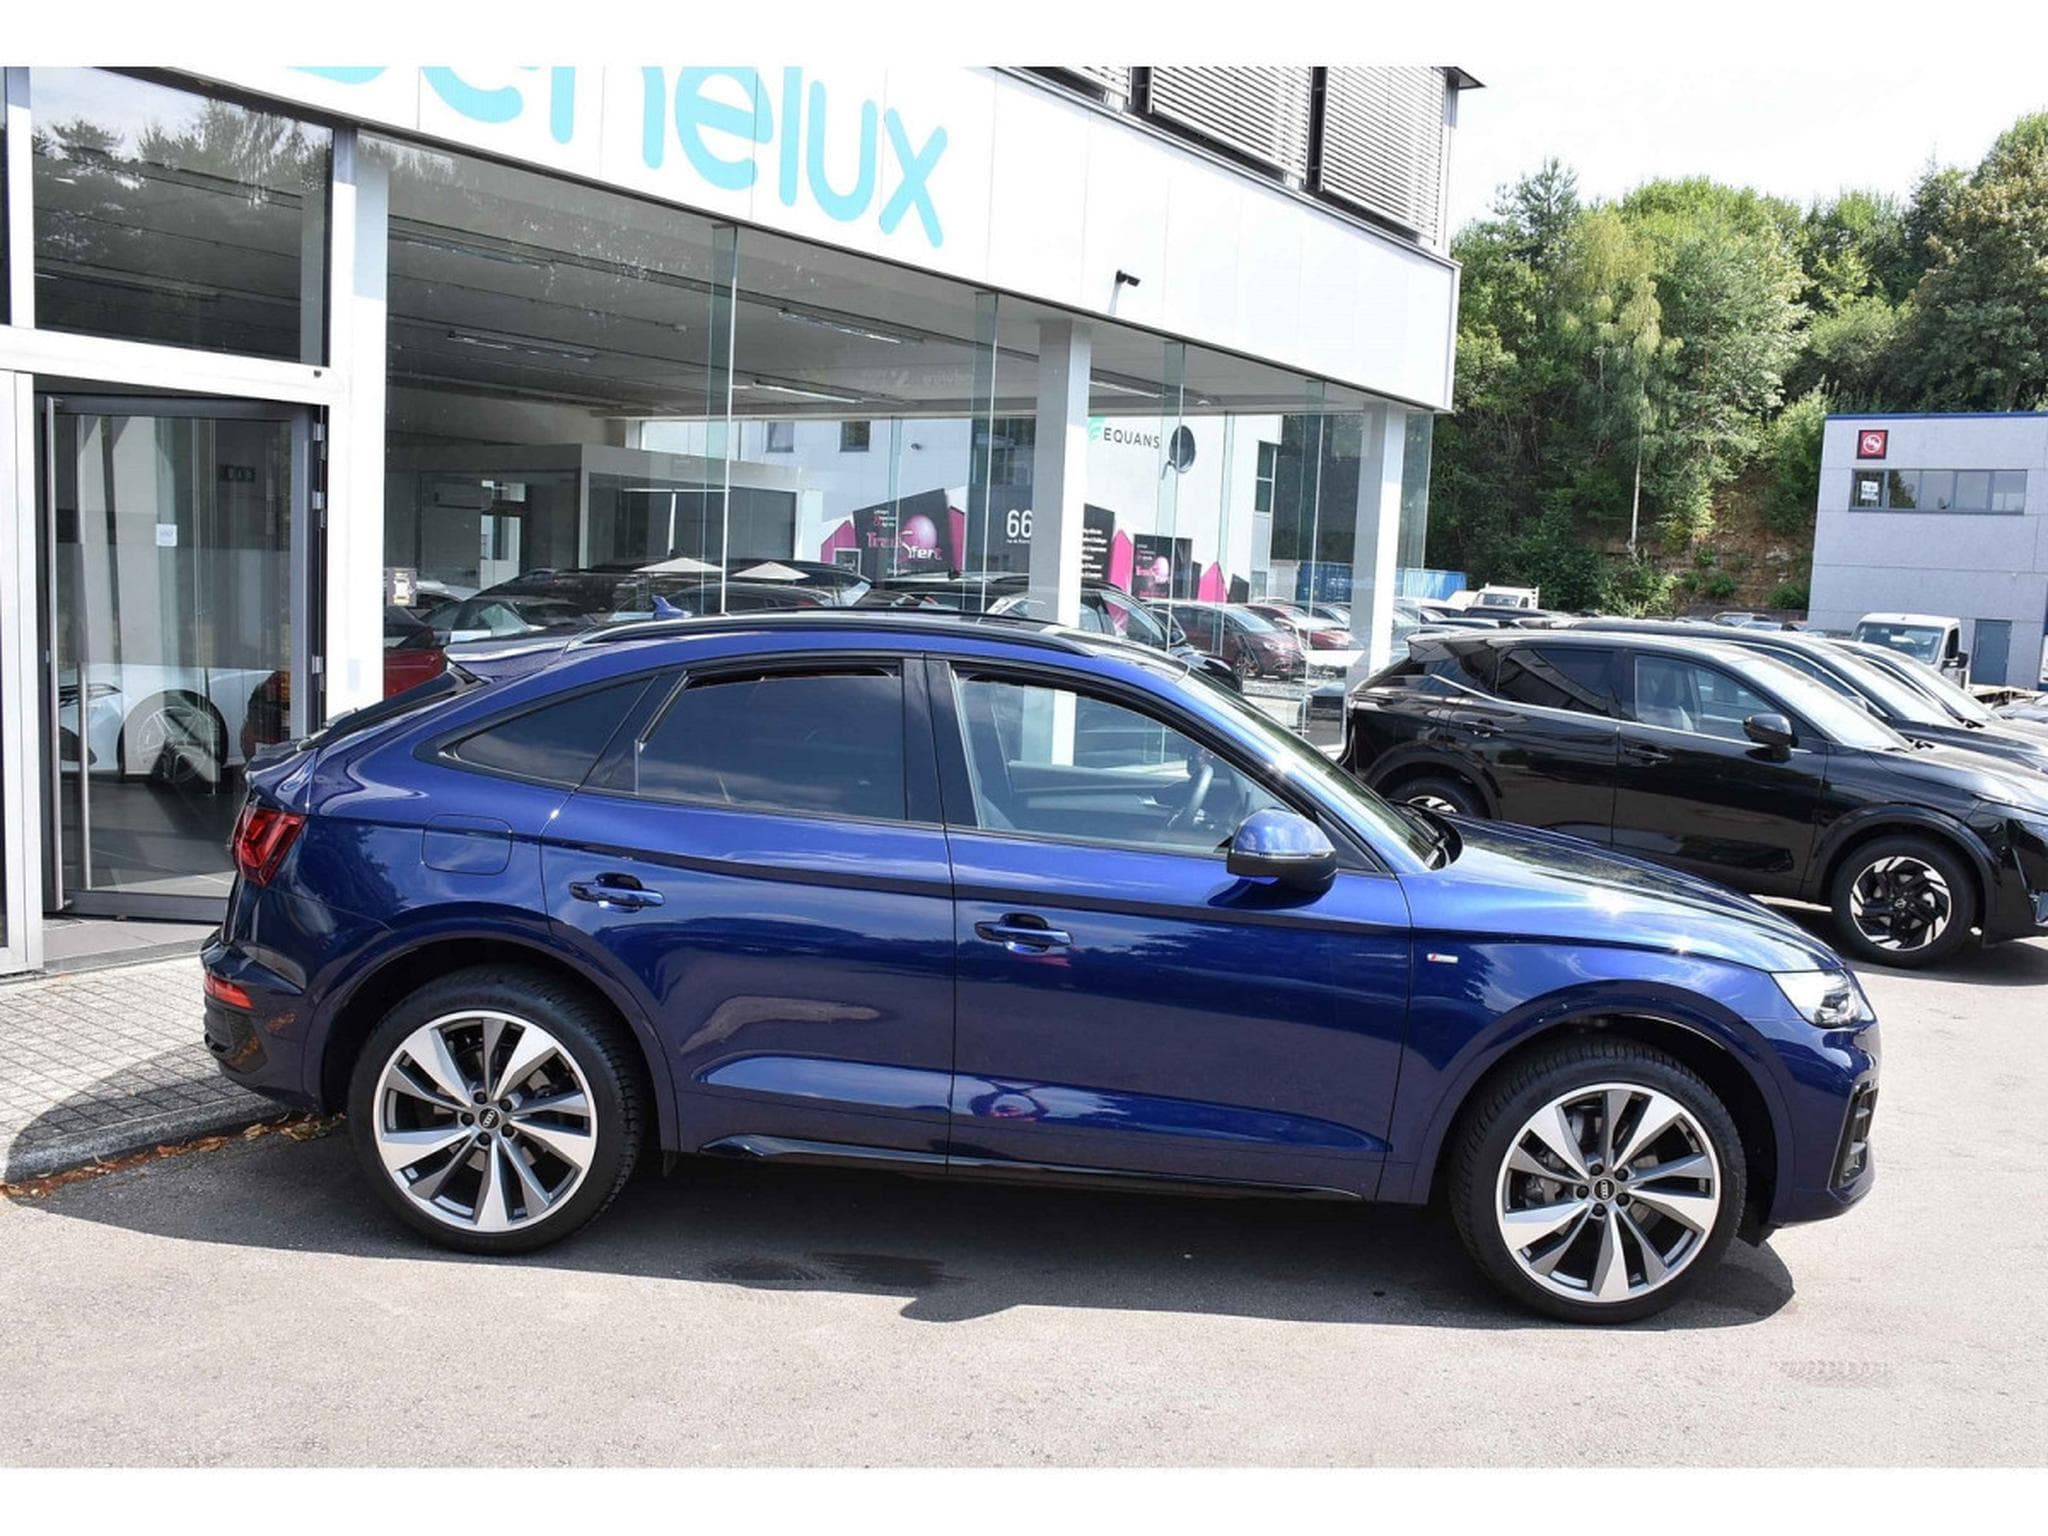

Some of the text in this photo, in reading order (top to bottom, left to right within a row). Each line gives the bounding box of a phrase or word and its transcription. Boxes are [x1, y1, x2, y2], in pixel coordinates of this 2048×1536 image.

[285, 67, 948, 248] nelux
[1103, 427, 1160, 449] EQUANS
[1006, 509, 1032, 538] 66
